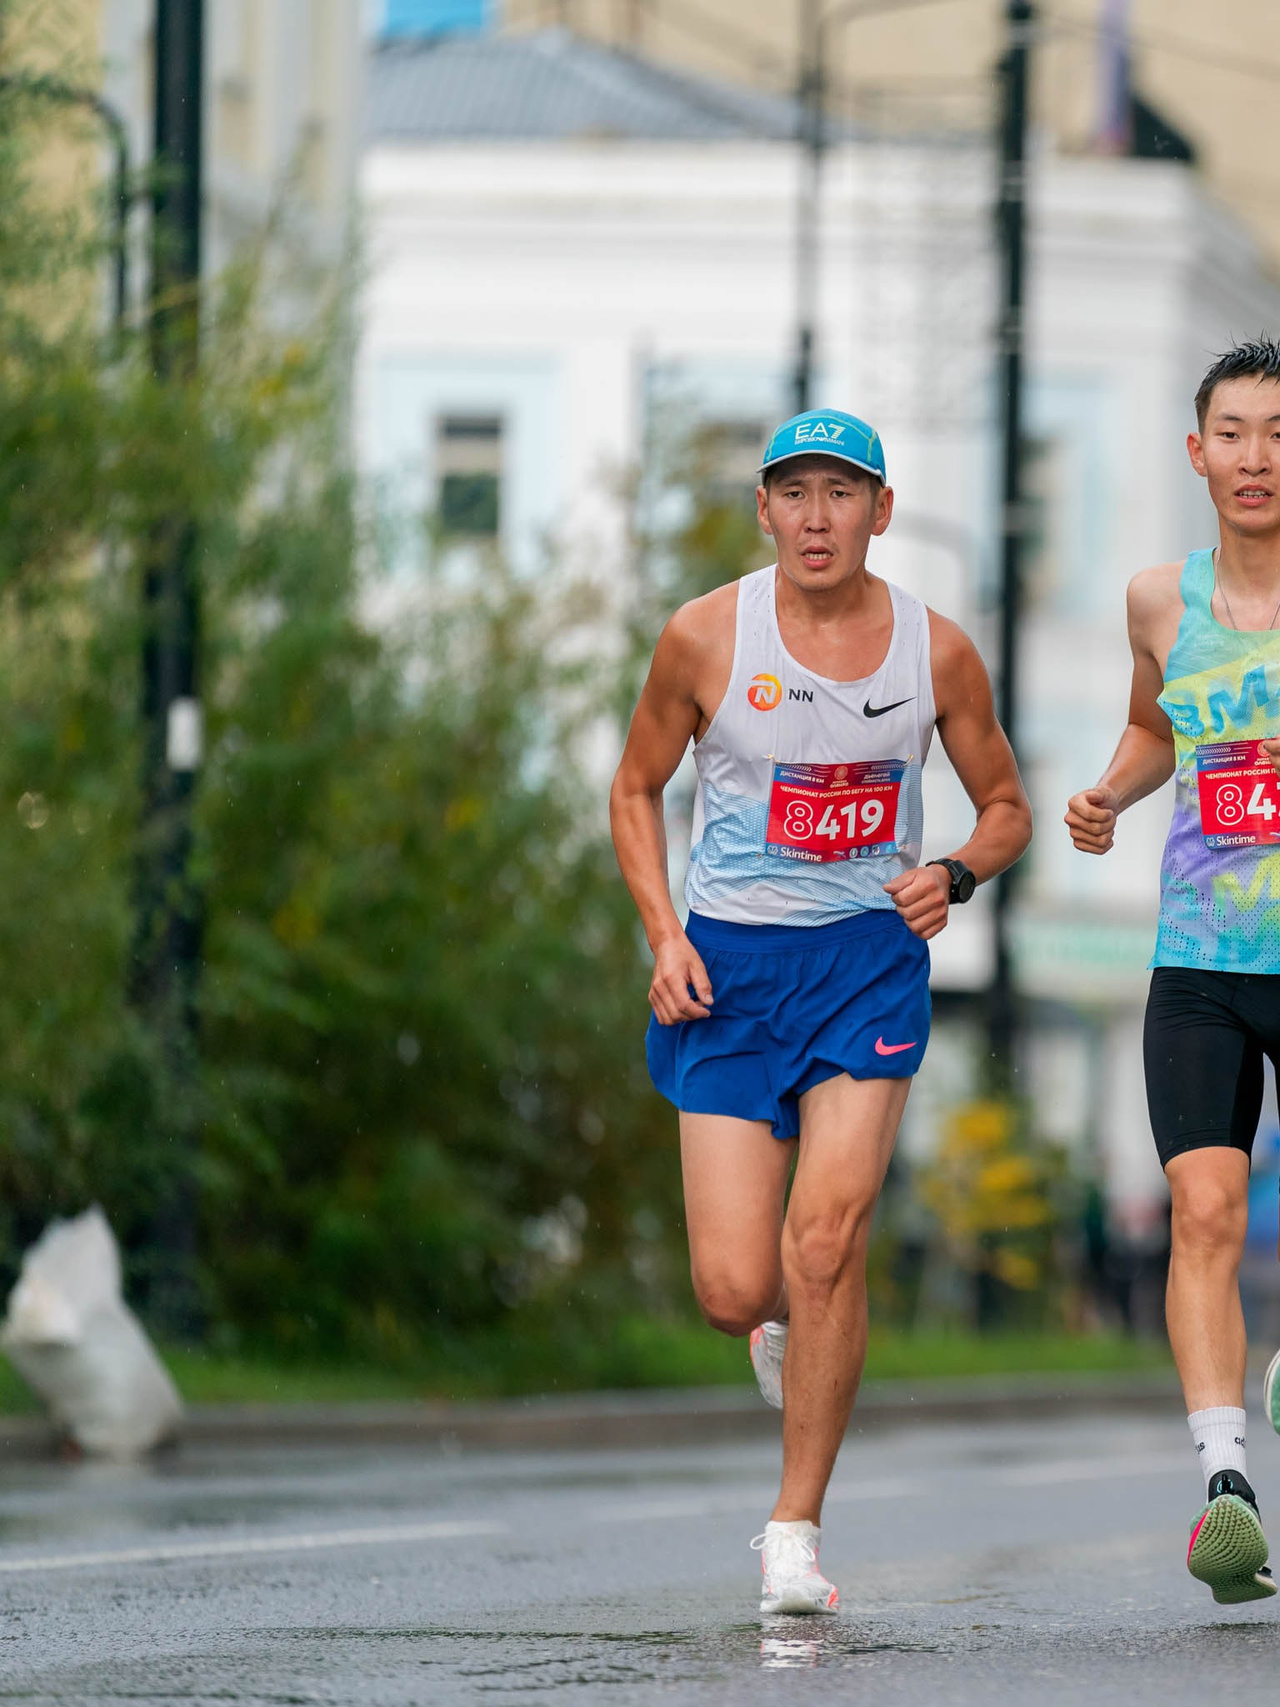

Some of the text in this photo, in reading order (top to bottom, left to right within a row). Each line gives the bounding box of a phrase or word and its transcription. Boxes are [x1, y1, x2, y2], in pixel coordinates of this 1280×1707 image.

[795, 422, 846, 440] EA7
[788, 688, 814, 703] NN
[1202, 757, 1233, 765] ДИСТАНЦИЯ
[780, 771, 812, 781] ДИСТАНЦИЯ
[1205, 771, 1242, 780] ЧЕМПИОНАТ
[1243, 769, 1271, 777] РОССИИ
[780, 785, 819, 798] ЧЕМПИОНАТ
[819, 791, 841, 799] РОССИИ
[783, 799, 885, 840] 8419
[1216, 834, 1256, 846] Skintime
[780, 847, 822, 862] Skintime
